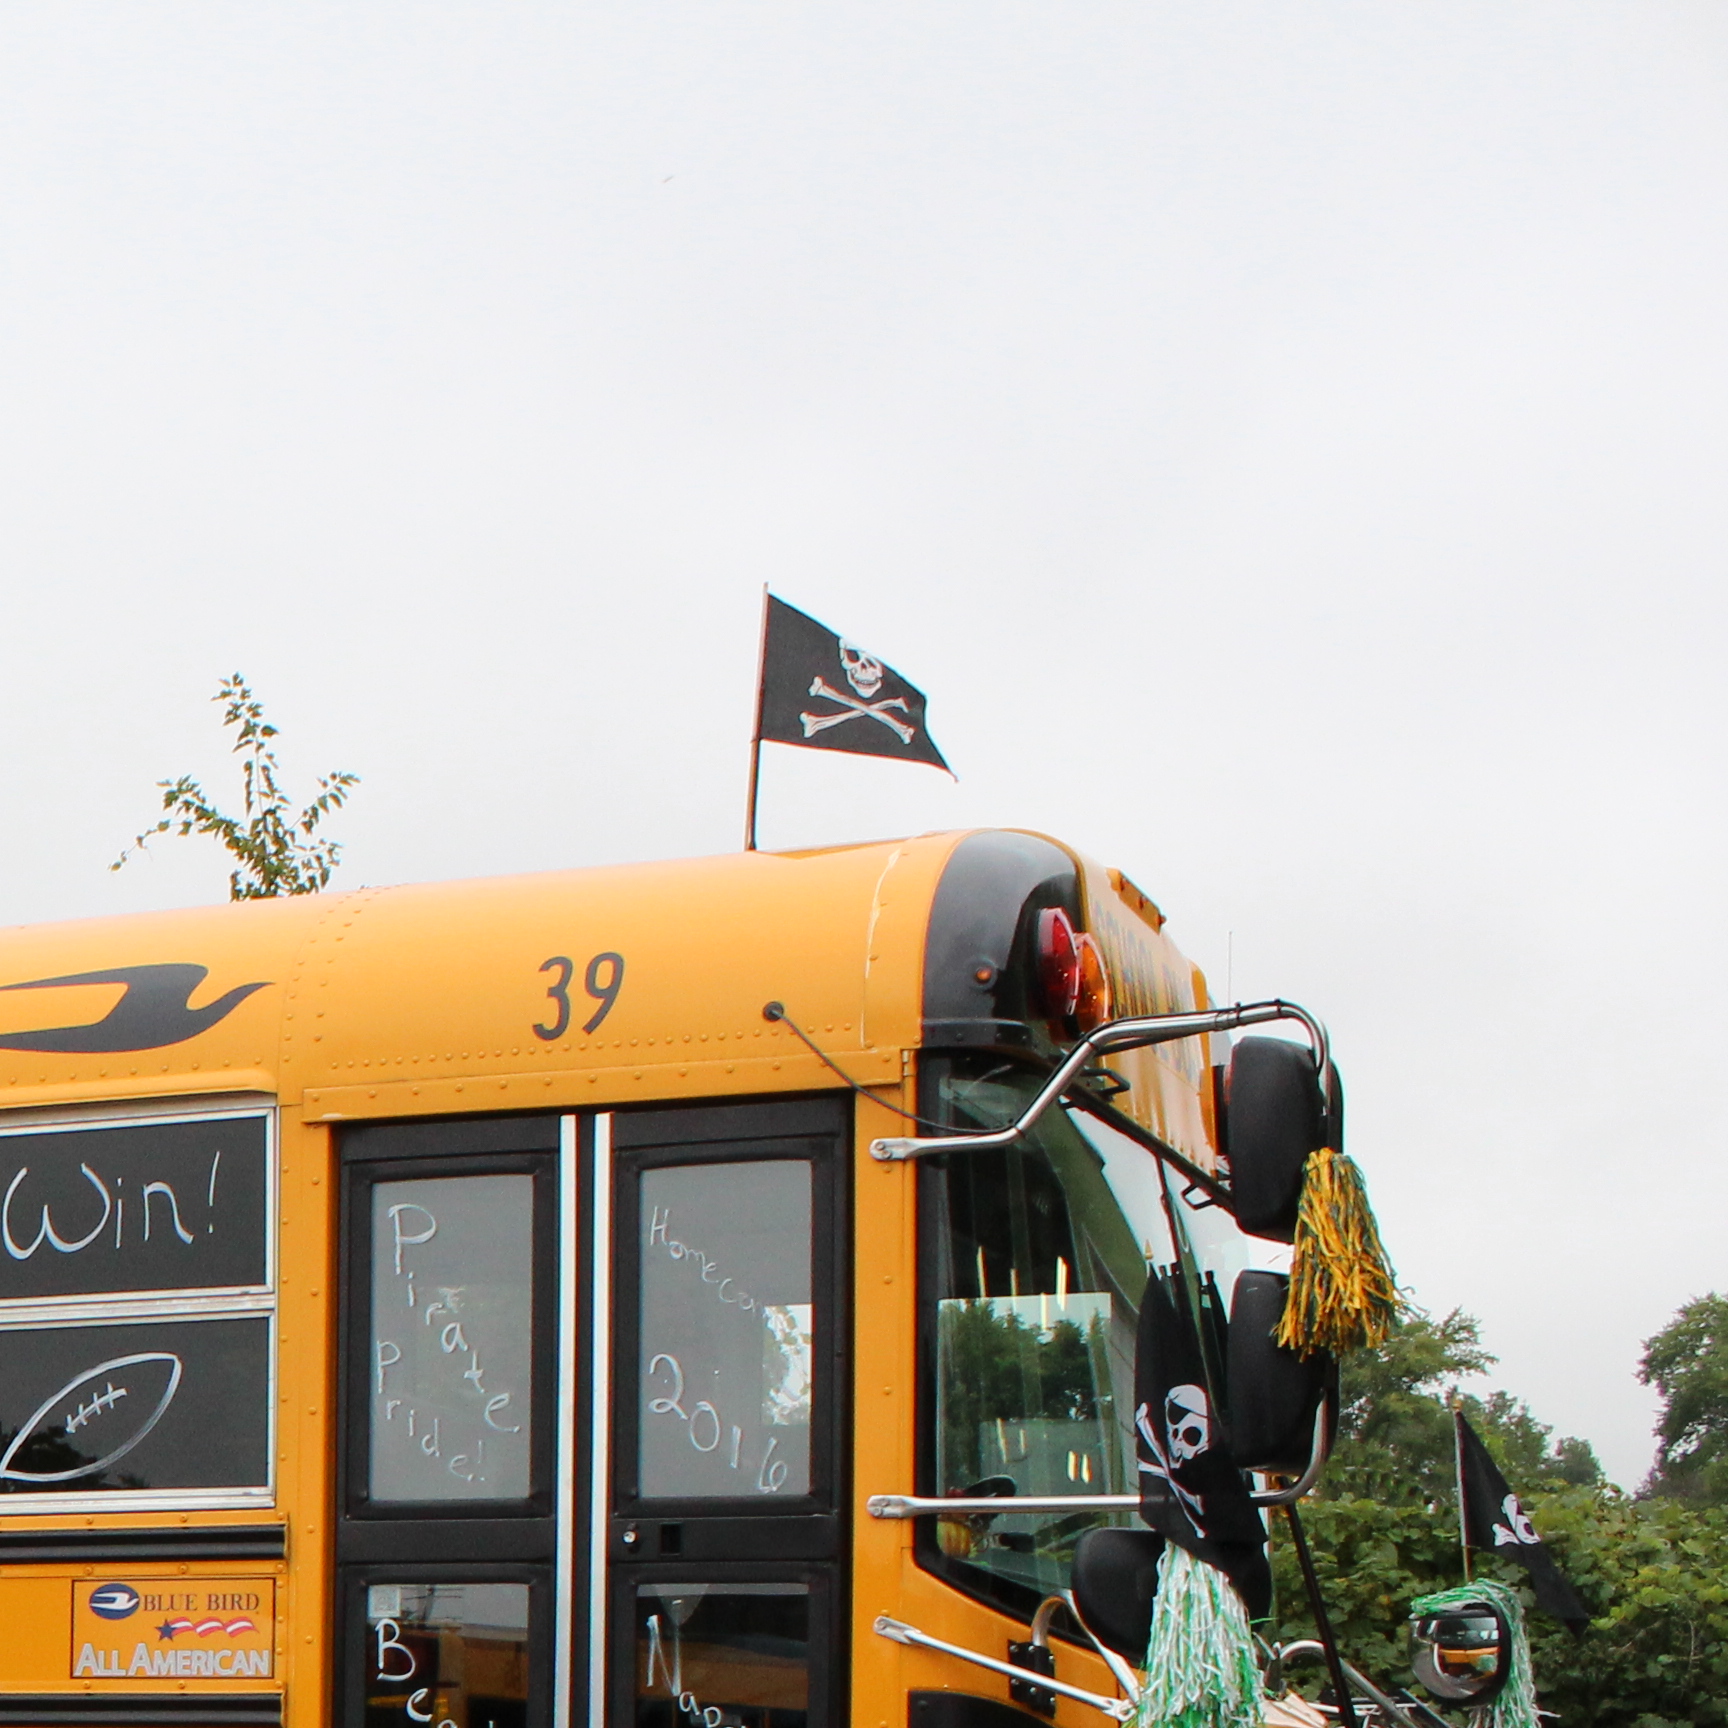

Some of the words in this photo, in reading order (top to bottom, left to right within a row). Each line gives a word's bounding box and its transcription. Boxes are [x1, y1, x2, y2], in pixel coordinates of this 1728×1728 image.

[532, 952, 625, 1041] 39
[2, 1151, 221, 1260] Win!
[389, 1204, 521, 1432] Pirate
[377, 1340, 486, 1482] Pride!
[648, 1354, 787, 1493] 2016
[144, 1594, 198, 1611] BLUE
[207, 1593, 260, 1611] BIRD
[72, 1642, 127, 1676] ALL
[126, 1642, 271, 1676] AMERICAN
